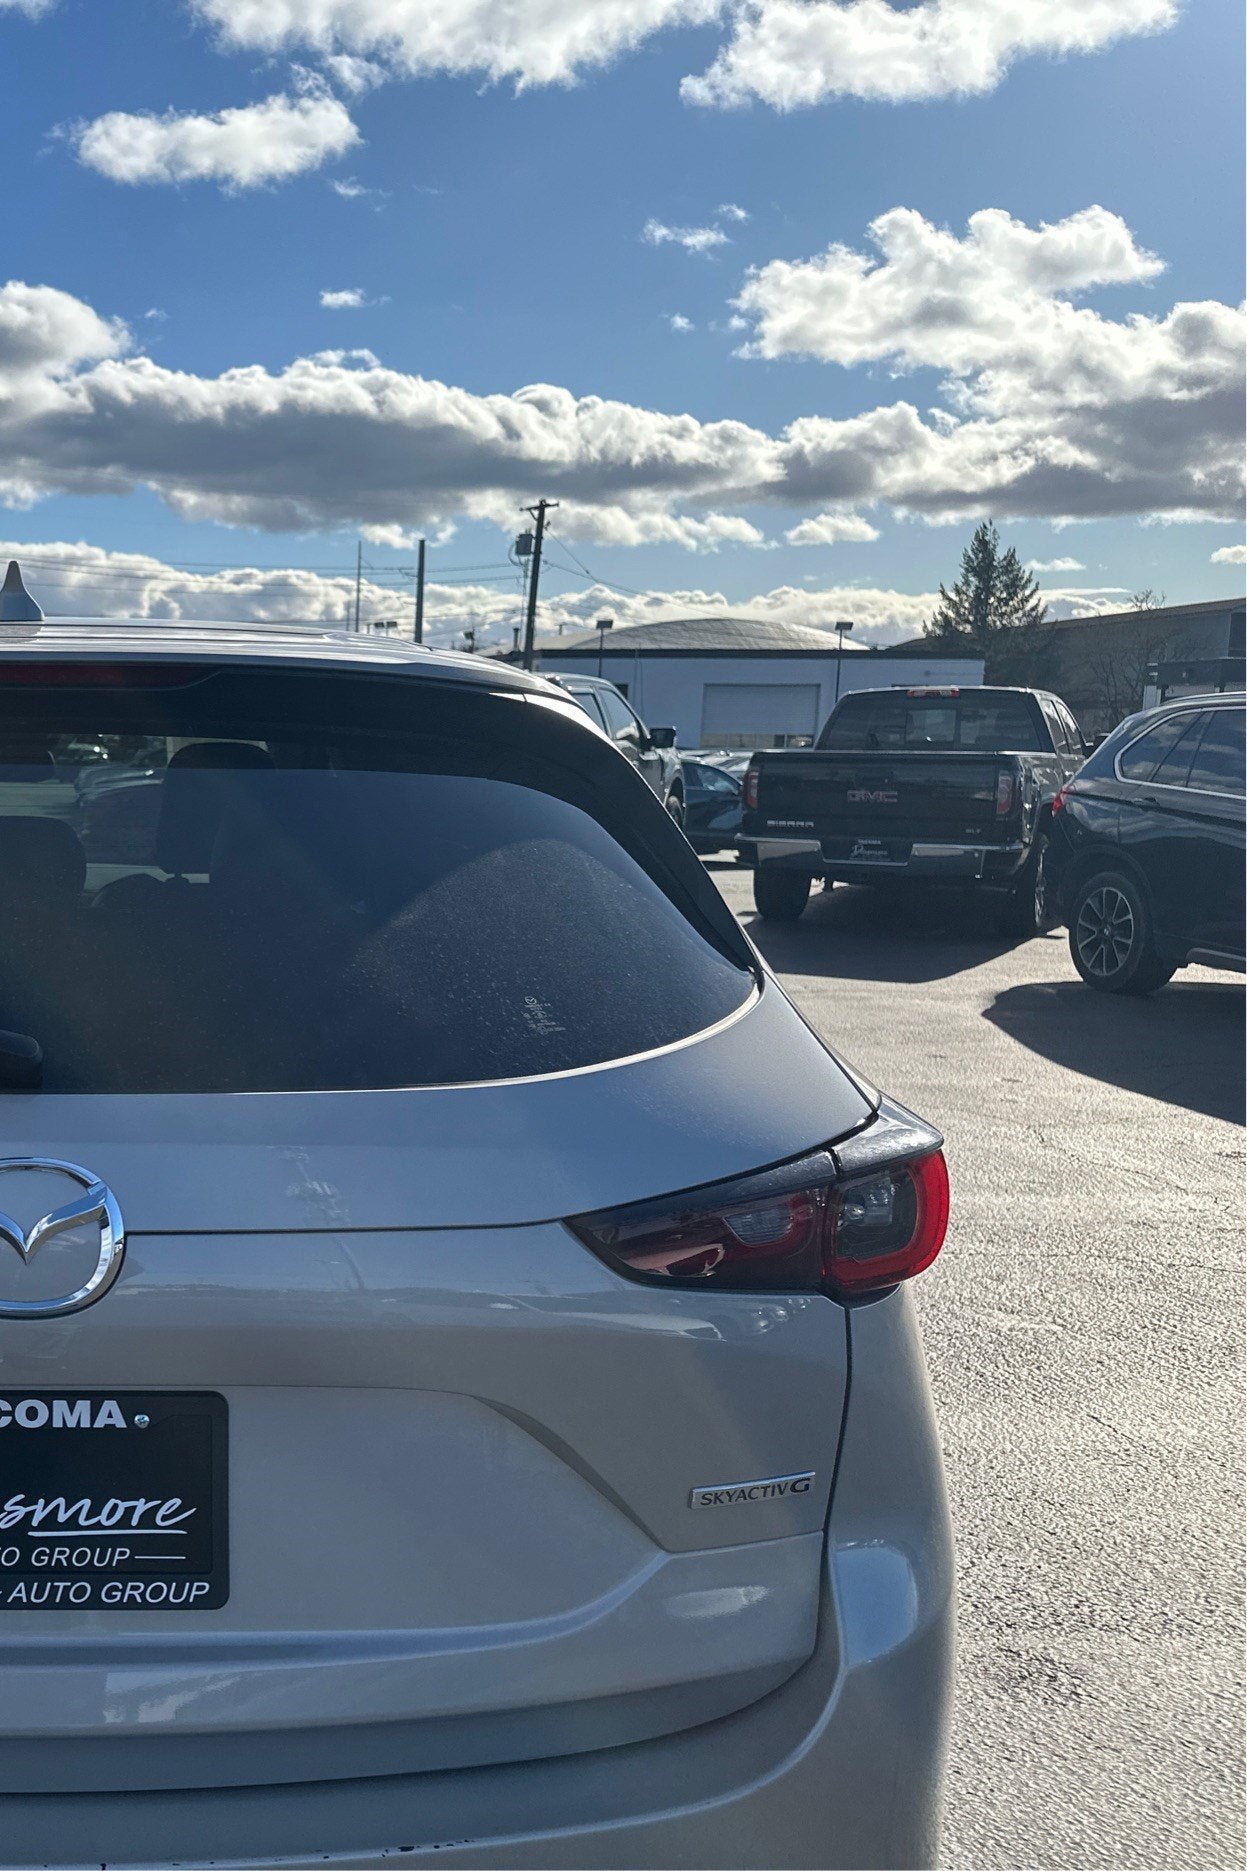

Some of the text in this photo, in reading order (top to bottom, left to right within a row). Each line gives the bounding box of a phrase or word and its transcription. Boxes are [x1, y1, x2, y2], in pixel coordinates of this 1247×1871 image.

[847, 789, 899, 803] GMC
[31, 1546, 132, 1567] GROUP
[6, 1581, 92, 1604] AUTO
[99, 1581, 211, 1604] GROUP
